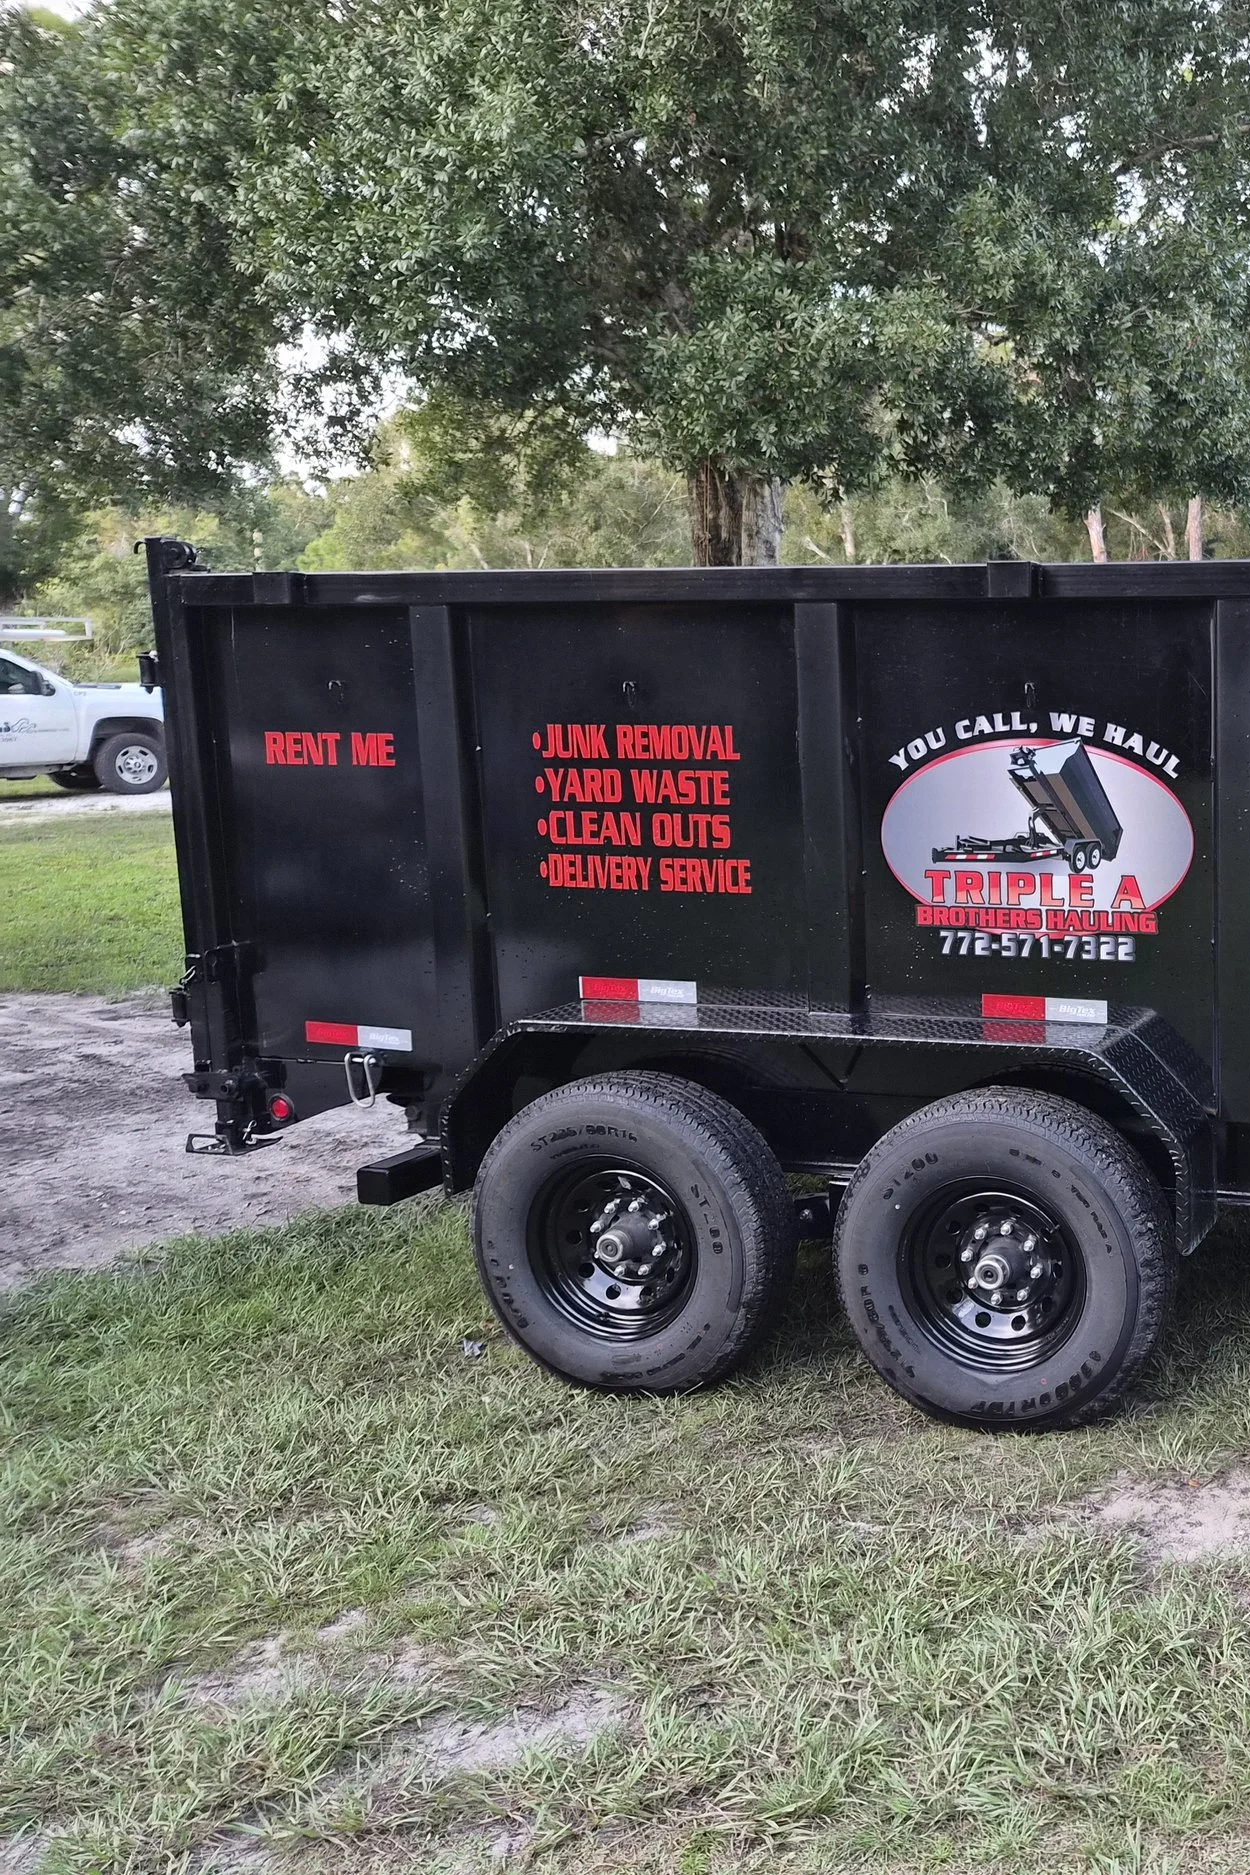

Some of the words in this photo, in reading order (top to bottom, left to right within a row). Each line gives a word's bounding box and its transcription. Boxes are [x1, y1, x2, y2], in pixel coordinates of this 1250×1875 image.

[264, 731, 341, 766] RENT
[351, 732, 396, 767] ME
[542, 724, 610, 759] JUNK
[616, 725, 741, 760] REMOVAL
[888, 727, 946, 771] YOU
[955, 711, 1038, 740] CALL,
[1049, 712, 1096, 737] WE
[1102, 723, 1180, 779] HAUL
[544, 768, 622, 803] YARD
[630, 769, 731, 806] WASTE
[549, 810, 641, 846] CLEAN
[652, 813, 731, 849] OUTS
[548, 854, 651, 891] DELIVERY
[660, 858, 752, 894] SERVICE
[924, 869, 1095, 908] TRIPLE
[1111, 875, 1146, 910] A
[916, 904, 1042, 930] BROTHERS
[1046, 910, 1158, 934] HAULING
[939, 930, 1136, 963] 772-571-7322
[1060, 1004, 1096, 1016] BigTex
